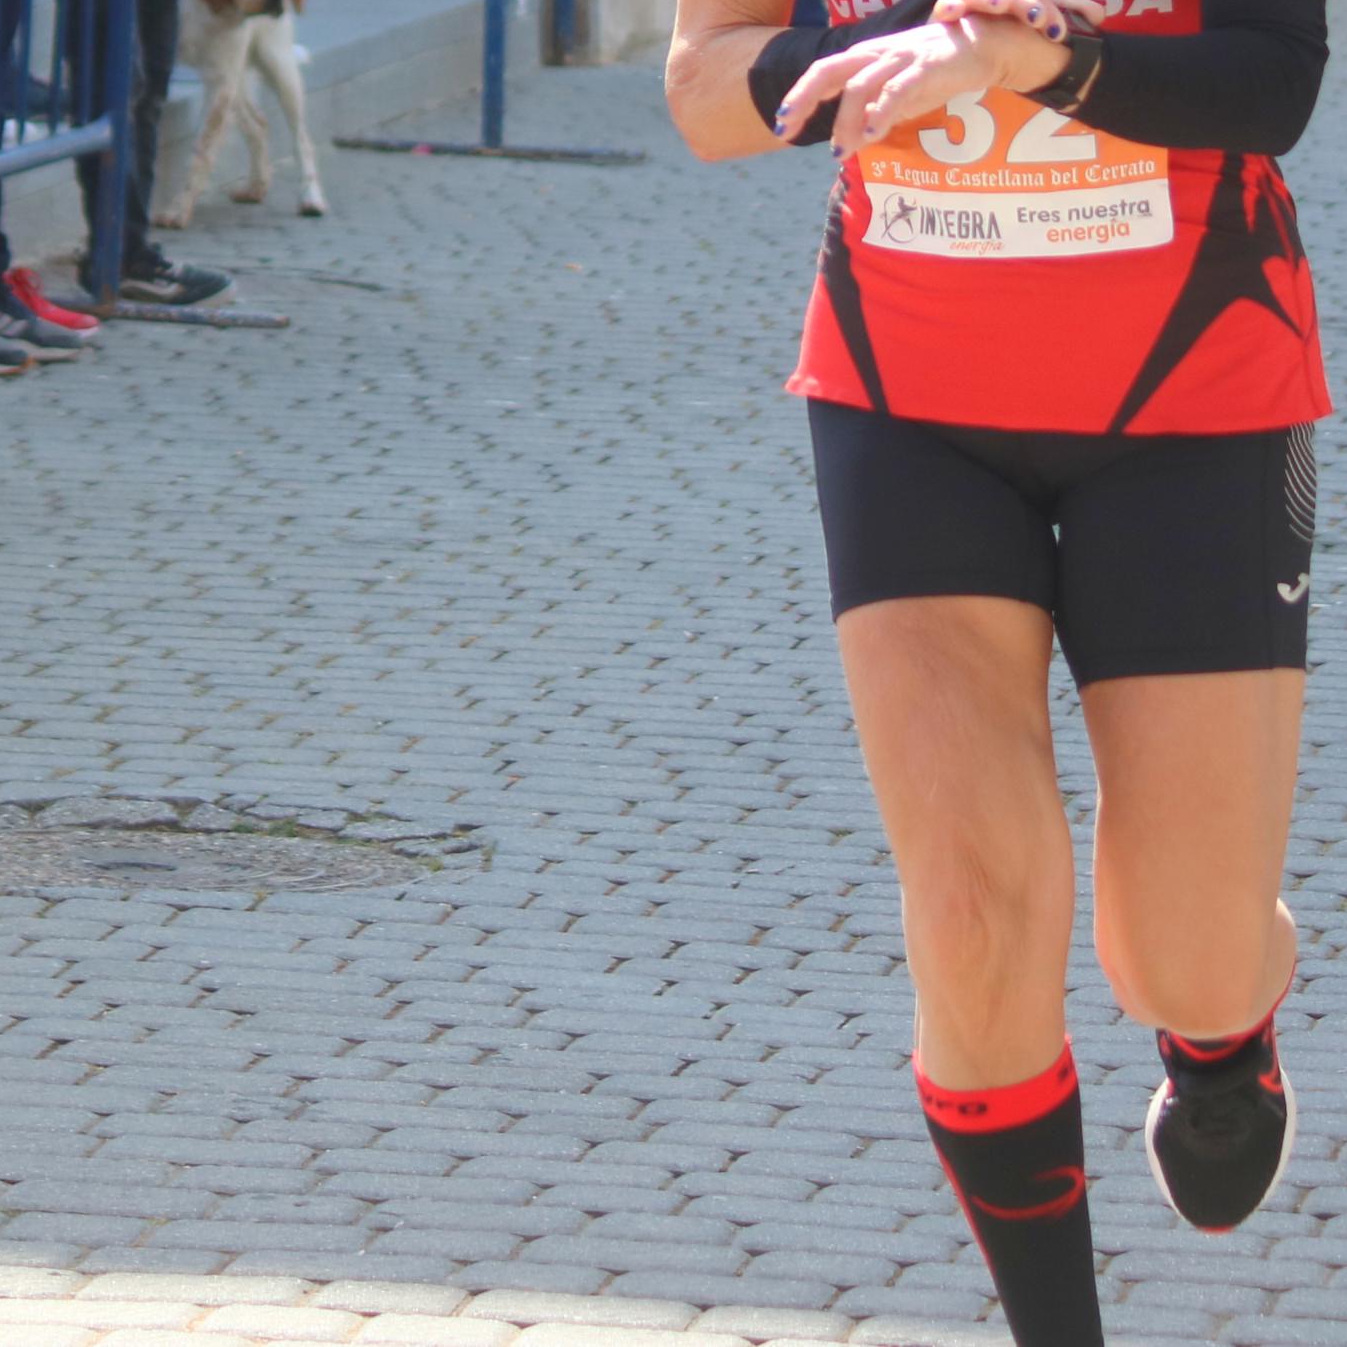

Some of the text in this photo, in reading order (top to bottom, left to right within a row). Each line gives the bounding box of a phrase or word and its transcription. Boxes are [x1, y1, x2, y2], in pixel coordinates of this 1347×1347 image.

[918, 87, 1097, 164] 32
[891, 162, 939, 185] Legua
[945, 168, 1044, 188] Castellana
[1051, 167, 1078, 185] del
[1085, 160, 1155, 183] Cerrato
[920, 205, 1001, 239] INTEGRA
[1017, 199, 1150, 223] Eres nuestra
[1046, 218, 1131, 243] energía
